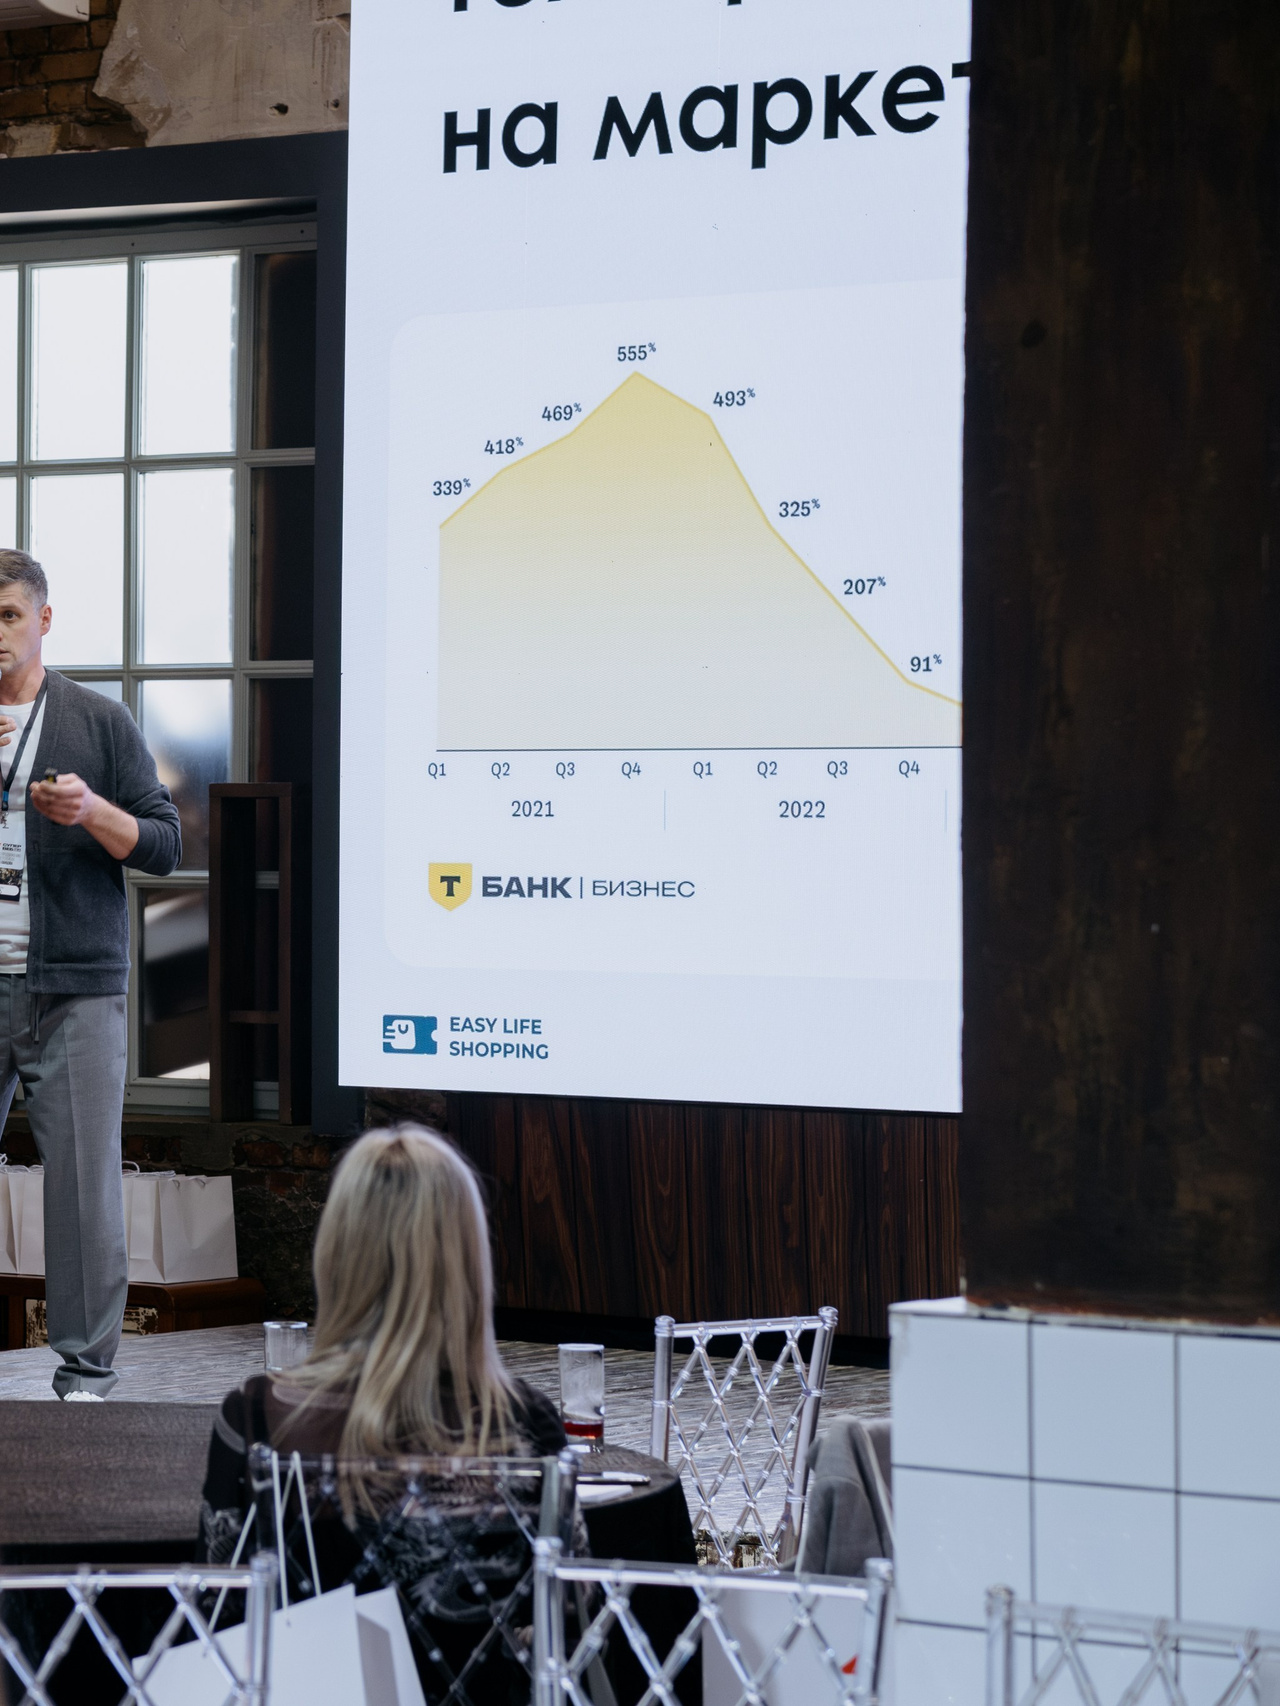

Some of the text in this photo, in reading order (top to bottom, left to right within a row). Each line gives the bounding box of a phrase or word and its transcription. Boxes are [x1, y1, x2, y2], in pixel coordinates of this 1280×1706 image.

[442, 101, 559, 175] на
[617, 342, 657, 363] 555%
[713, 387, 756, 408] 493%
[541, 402, 582, 422] 469%
[484, 436, 524, 456] 418%
[432, 477, 472, 497] 339%
[778, 498, 821, 518] 325%
[843, 575, 887, 596] 207%
[909, 653, 943, 673] 91%
[427, 760, 921, 779] Q1 Q2 Q3 Q4 Q1 Q2 Q3 Q4
[511, 799, 826, 819] 2021 2022
[481, 876, 573, 899] БАНК
[592, 879, 696, 899] БИЗНЕС
[449, 1016, 543, 1035] EASY LIFE
[449, 1040, 549, 1060] SHOPPING
